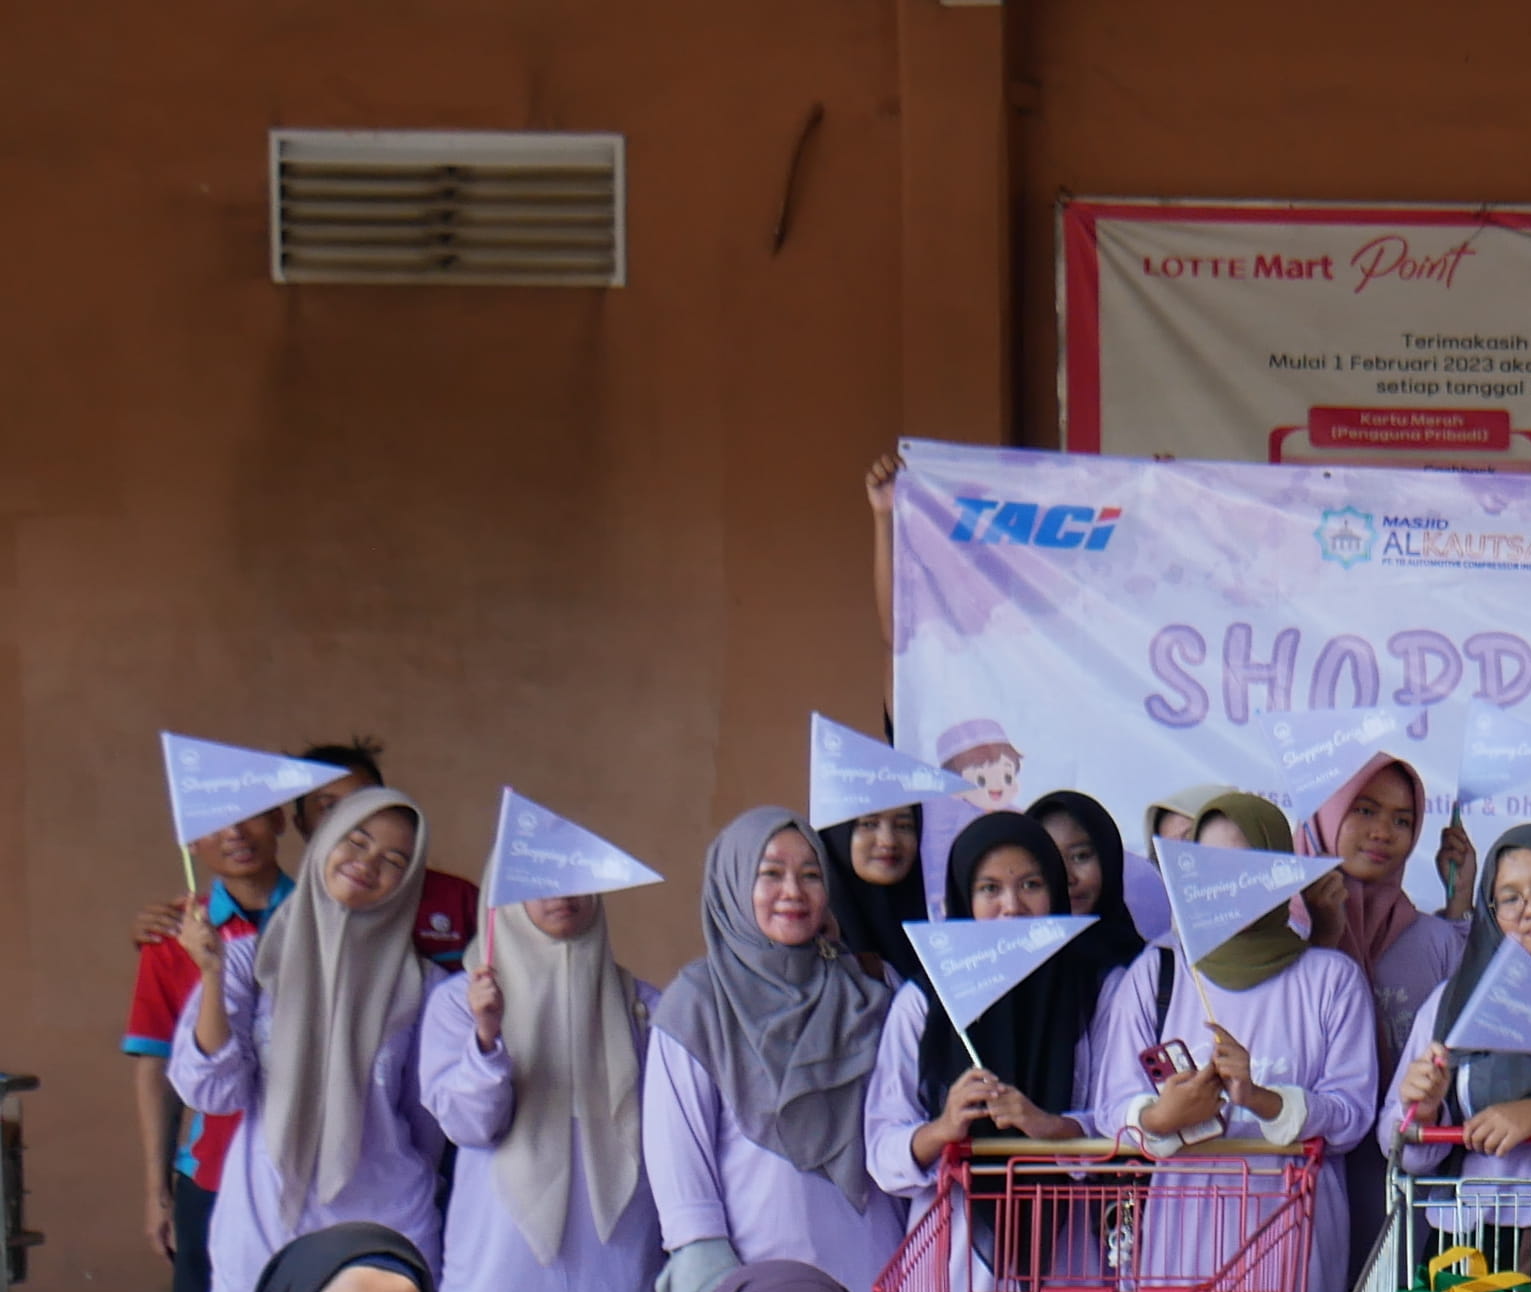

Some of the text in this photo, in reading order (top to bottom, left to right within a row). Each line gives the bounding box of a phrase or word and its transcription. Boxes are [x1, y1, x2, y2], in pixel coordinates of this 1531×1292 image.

[1142, 234, 1477, 294] LOTTE Mart Point
[1402, 332, 1527, 352] Terimakasih
[1267, 353, 1327, 371] Mulai
[1334, 354, 1343, 371] 1
[1350, 354, 1438, 372] Februari
[1443, 355, 1494, 373] 2023
[1376, 379, 1440, 397] setiap
[1446, 379, 1524, 398] tanggal
[1360, 412, 1465, 428] Kartu Merah
[1381, 515, 1450, 531] MASJID
[1183, 880, 1238, 902] Shopping
